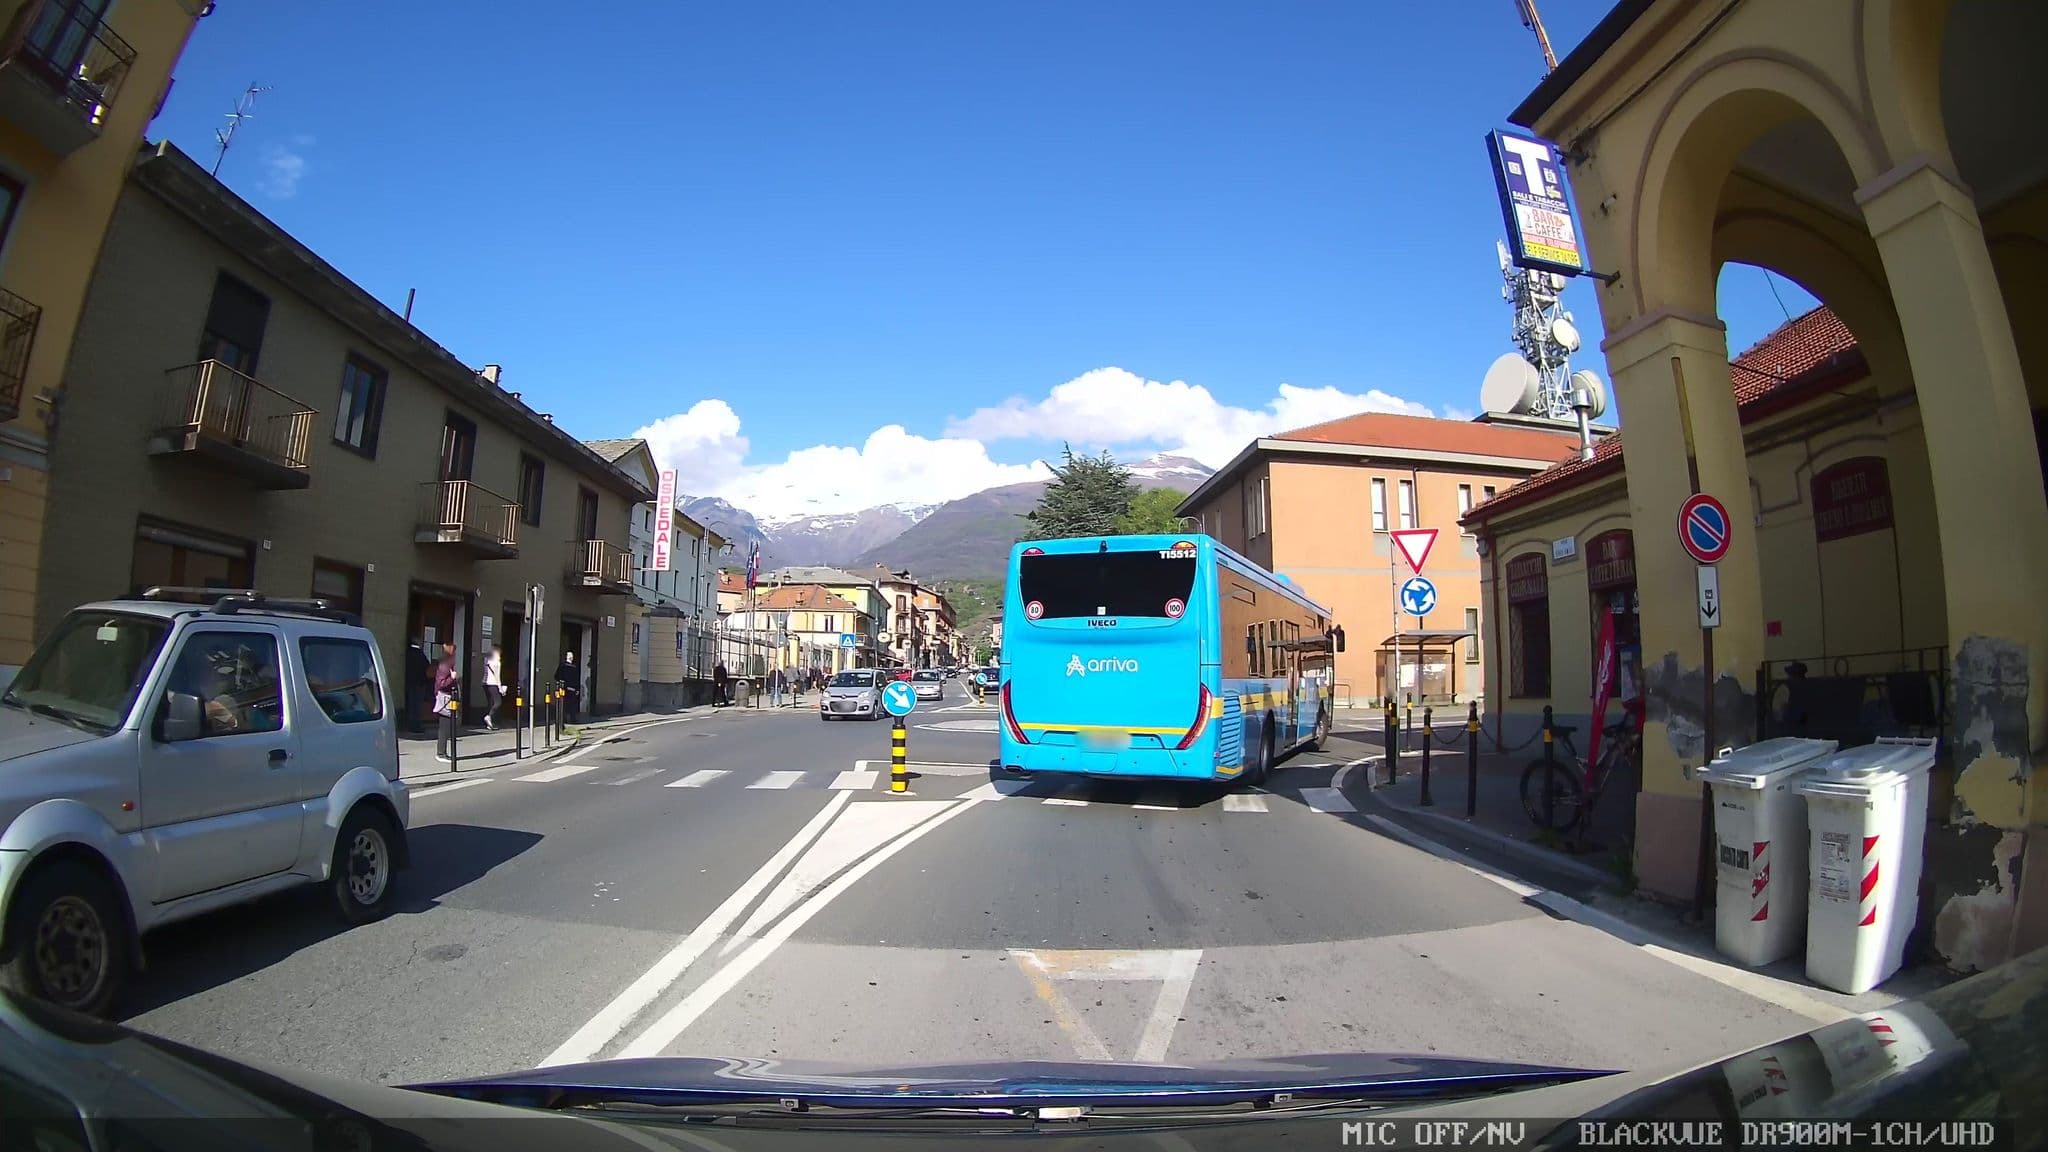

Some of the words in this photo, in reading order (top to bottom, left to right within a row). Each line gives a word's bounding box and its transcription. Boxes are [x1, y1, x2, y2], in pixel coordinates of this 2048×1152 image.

[1502, 136, 1550, 197] T
[1533, 208, 1555, 226] BAR
[656, 471, 673, 568] OSPEDALE
[1169, 603, 1181, 613] 100
[1087, 619, 1117, 627] IVECO
[1087, 657, 1139, 672] arriva
